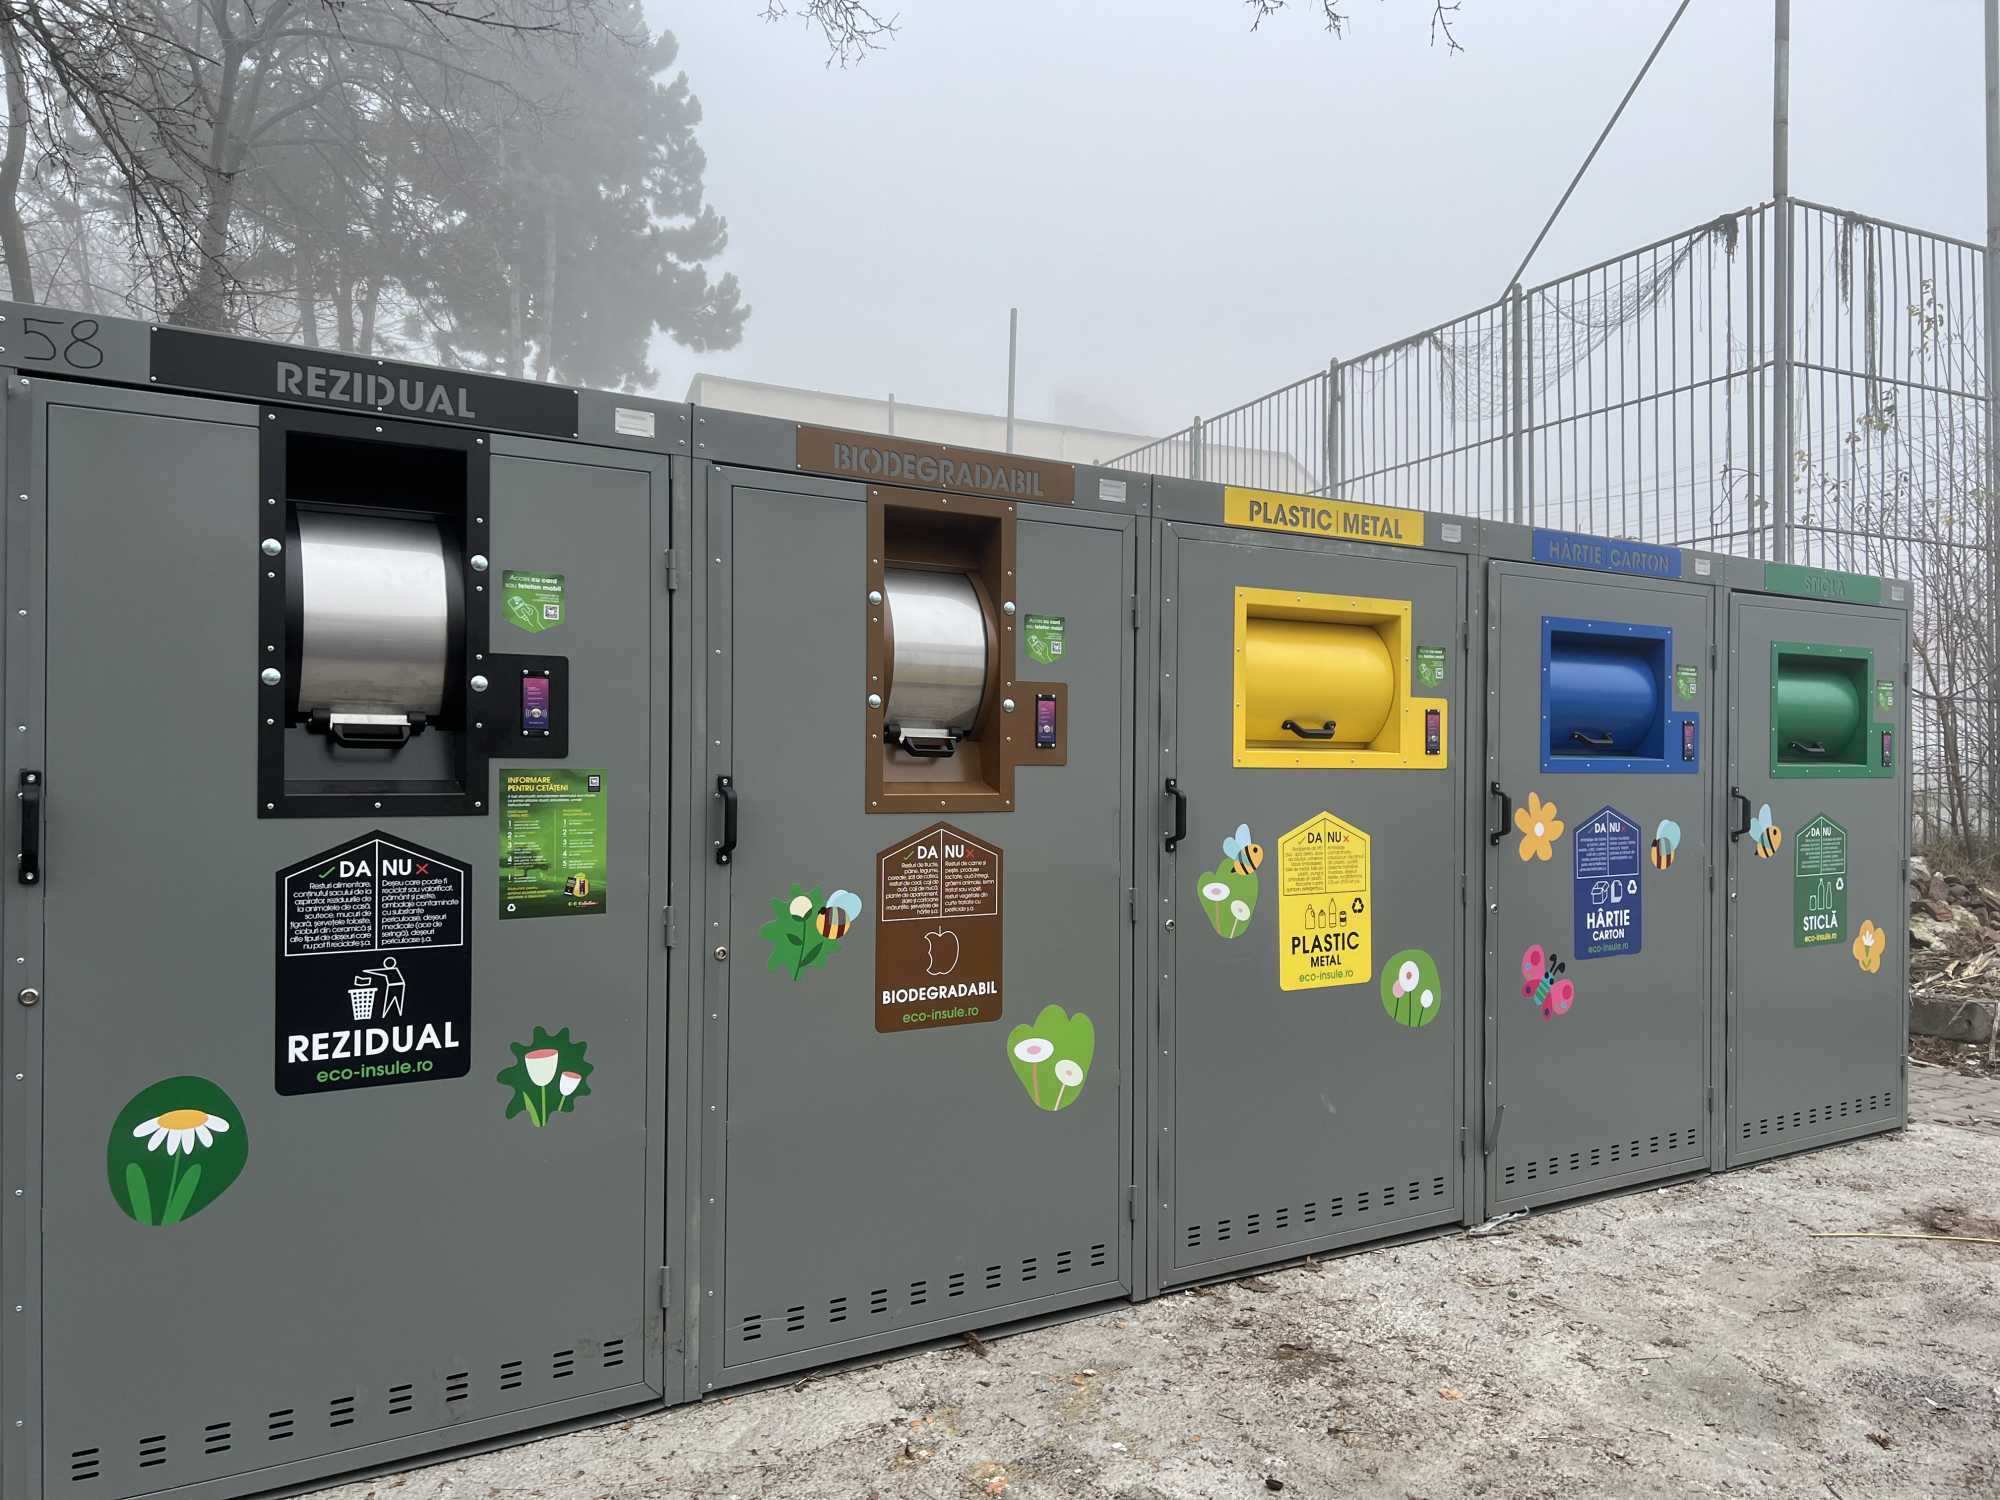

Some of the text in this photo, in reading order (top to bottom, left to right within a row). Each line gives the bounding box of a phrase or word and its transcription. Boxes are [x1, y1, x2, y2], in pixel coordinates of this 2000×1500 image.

[23, 316, 104, 369] 58
[276, 361, 476, 418] REZIDUAL
[833, 444, 1044, 497] BIODEGRADABIL
[1249, 501, 1404, 539] PLASTIC METAL
[1610, 549, 1671, 573] CARTON
[507, 784, 535, 792] PENTRU
[508, 776, 551, 784] INFORMARE
[1595, 823, 1606, 833] DA
[1609, 823, 1620, 832] NU
[1811, 828, 1820, 837] DA
[1823, 827, 1831, 836] NU
[1308, 832, 1322, 843] DA
[1328, 832, 1341, 842] NU
[917, 846, 938, 859] DA
[945, 845, 964, 858] NU
[340, 861, 371, 878] DA
[382, 859, 412, 875] NU
[1587, 908, 1630, 929] HÂRTIE
[1803, 910, 1838, 931] STICLĂ
[1593, 929, 1624, 941] CARTON
[1291, 932, 1359, 955] PLASTIC
[1311, 954, 1341, 968] METAL
[1299, 969, 1354, 982] eco-insule.ro
[882, 981, 997, 1004] BIODEGRADABIL
[903, 1007, 979, 1023] eco-insule.ro
[288, 1022, 459, 1063] REZIDUAL
[316, 1060, 433, 1083] eco-insule.ro
